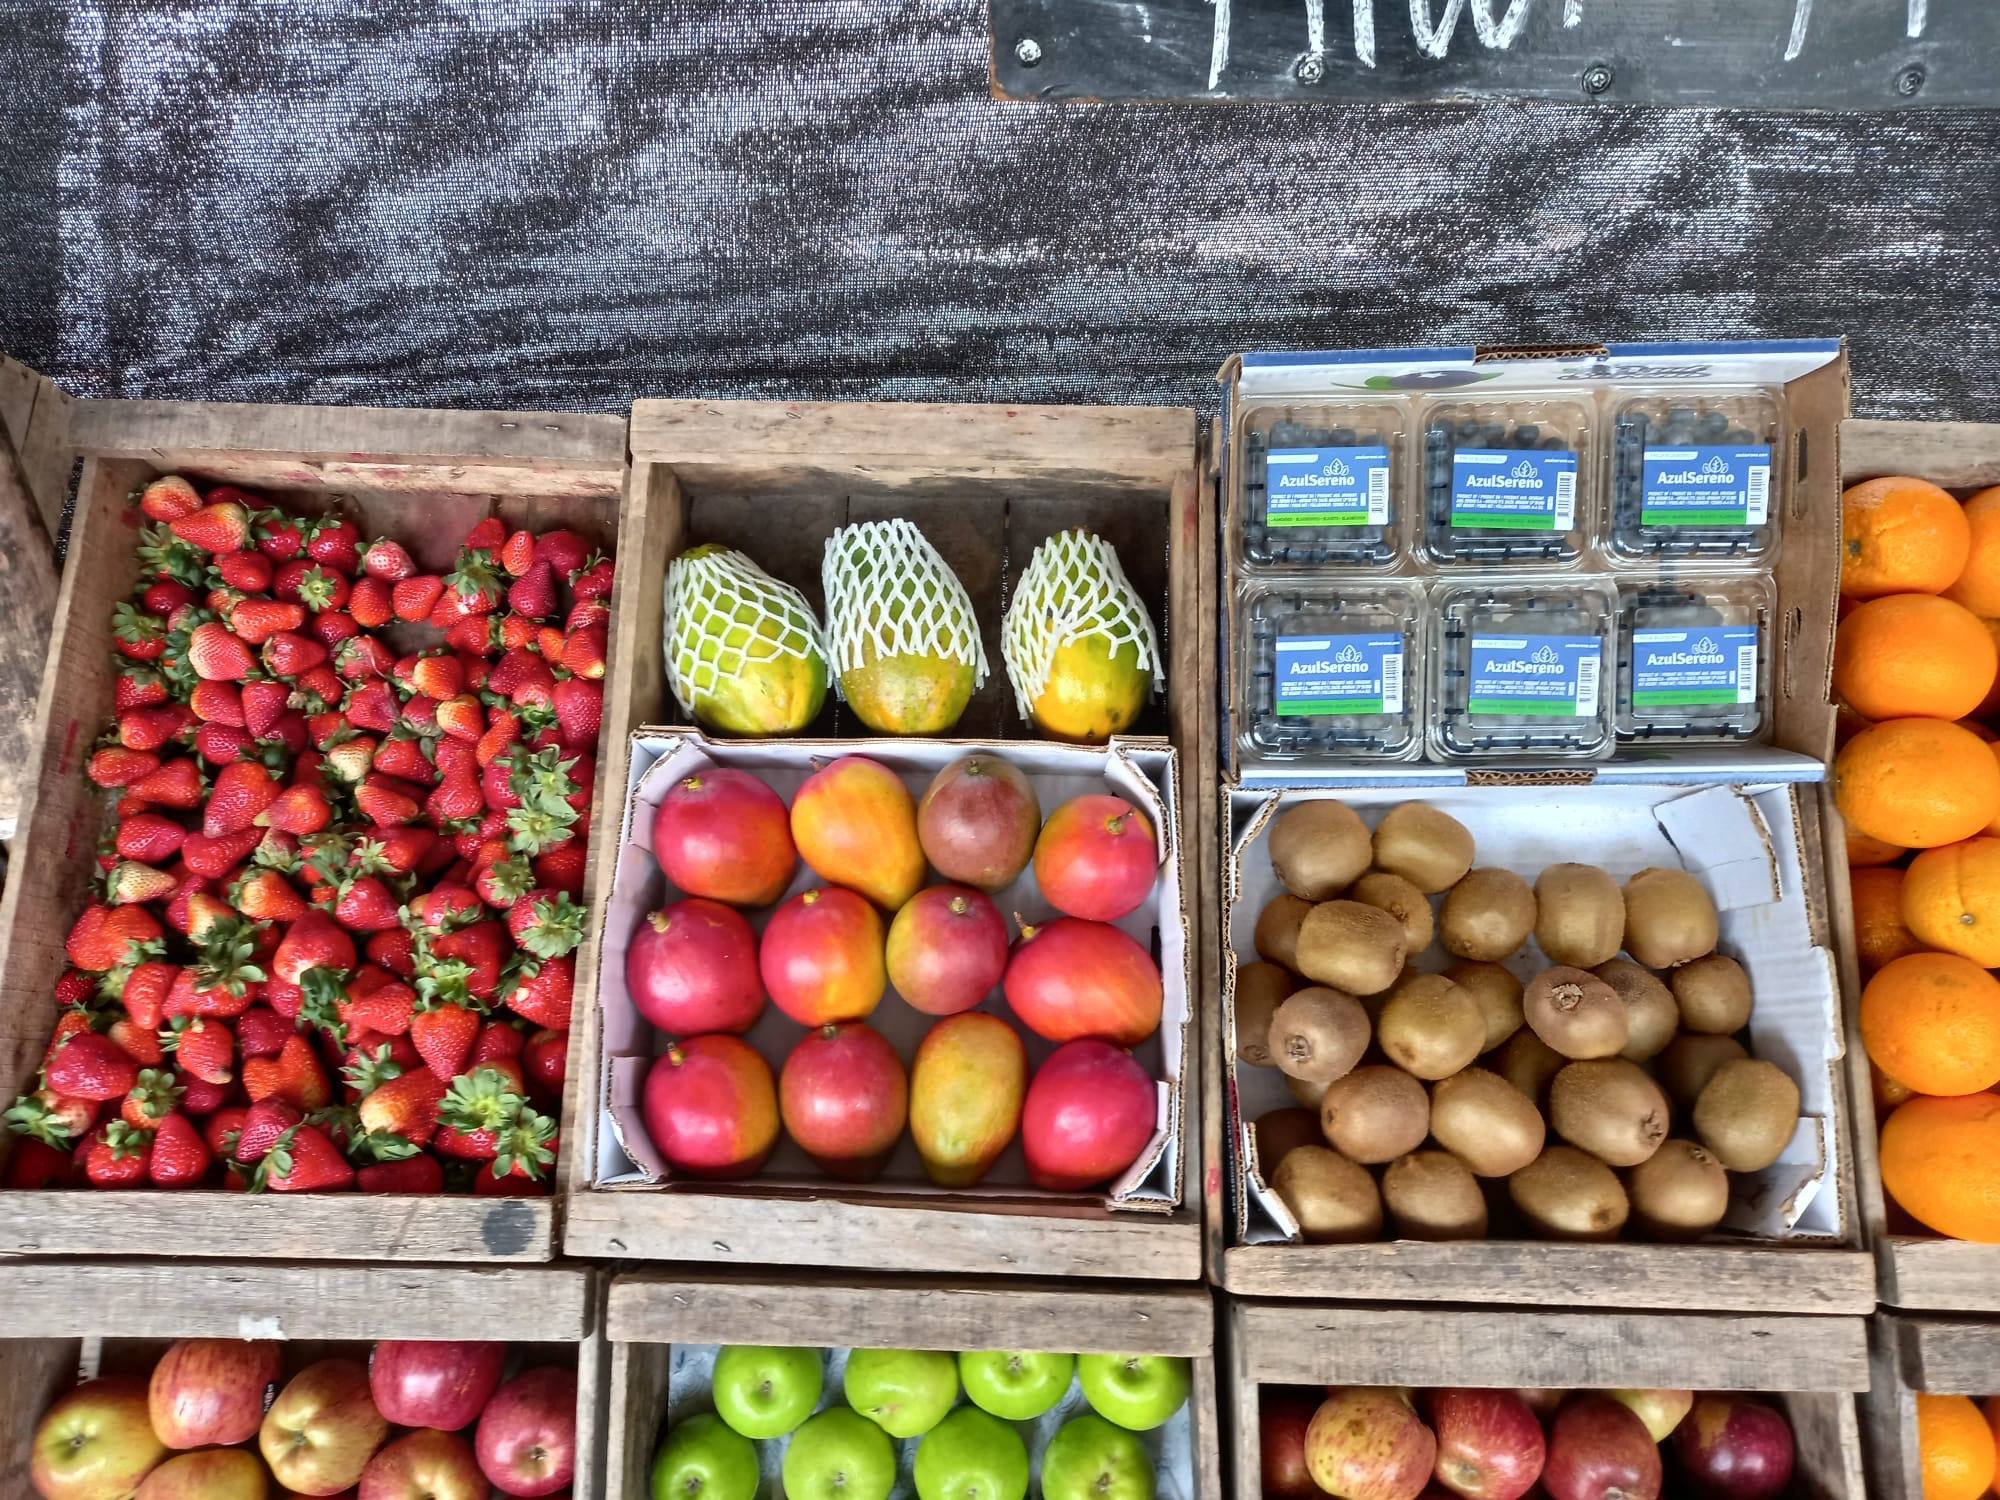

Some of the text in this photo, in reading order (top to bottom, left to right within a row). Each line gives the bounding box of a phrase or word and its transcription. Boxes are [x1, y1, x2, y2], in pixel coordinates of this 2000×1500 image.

[1279, 474, 1355, 487] AzulSereno
[1466, 474, 1543, 488] AzulSereno
[1657, 471, 1735, 484] AzulSereno
[1646, 652, 1725, 666] AzulSereno
[1290, 661, 1369, 675] AzulSereno
[1484, 660, 1564, 674] AzulSereno
